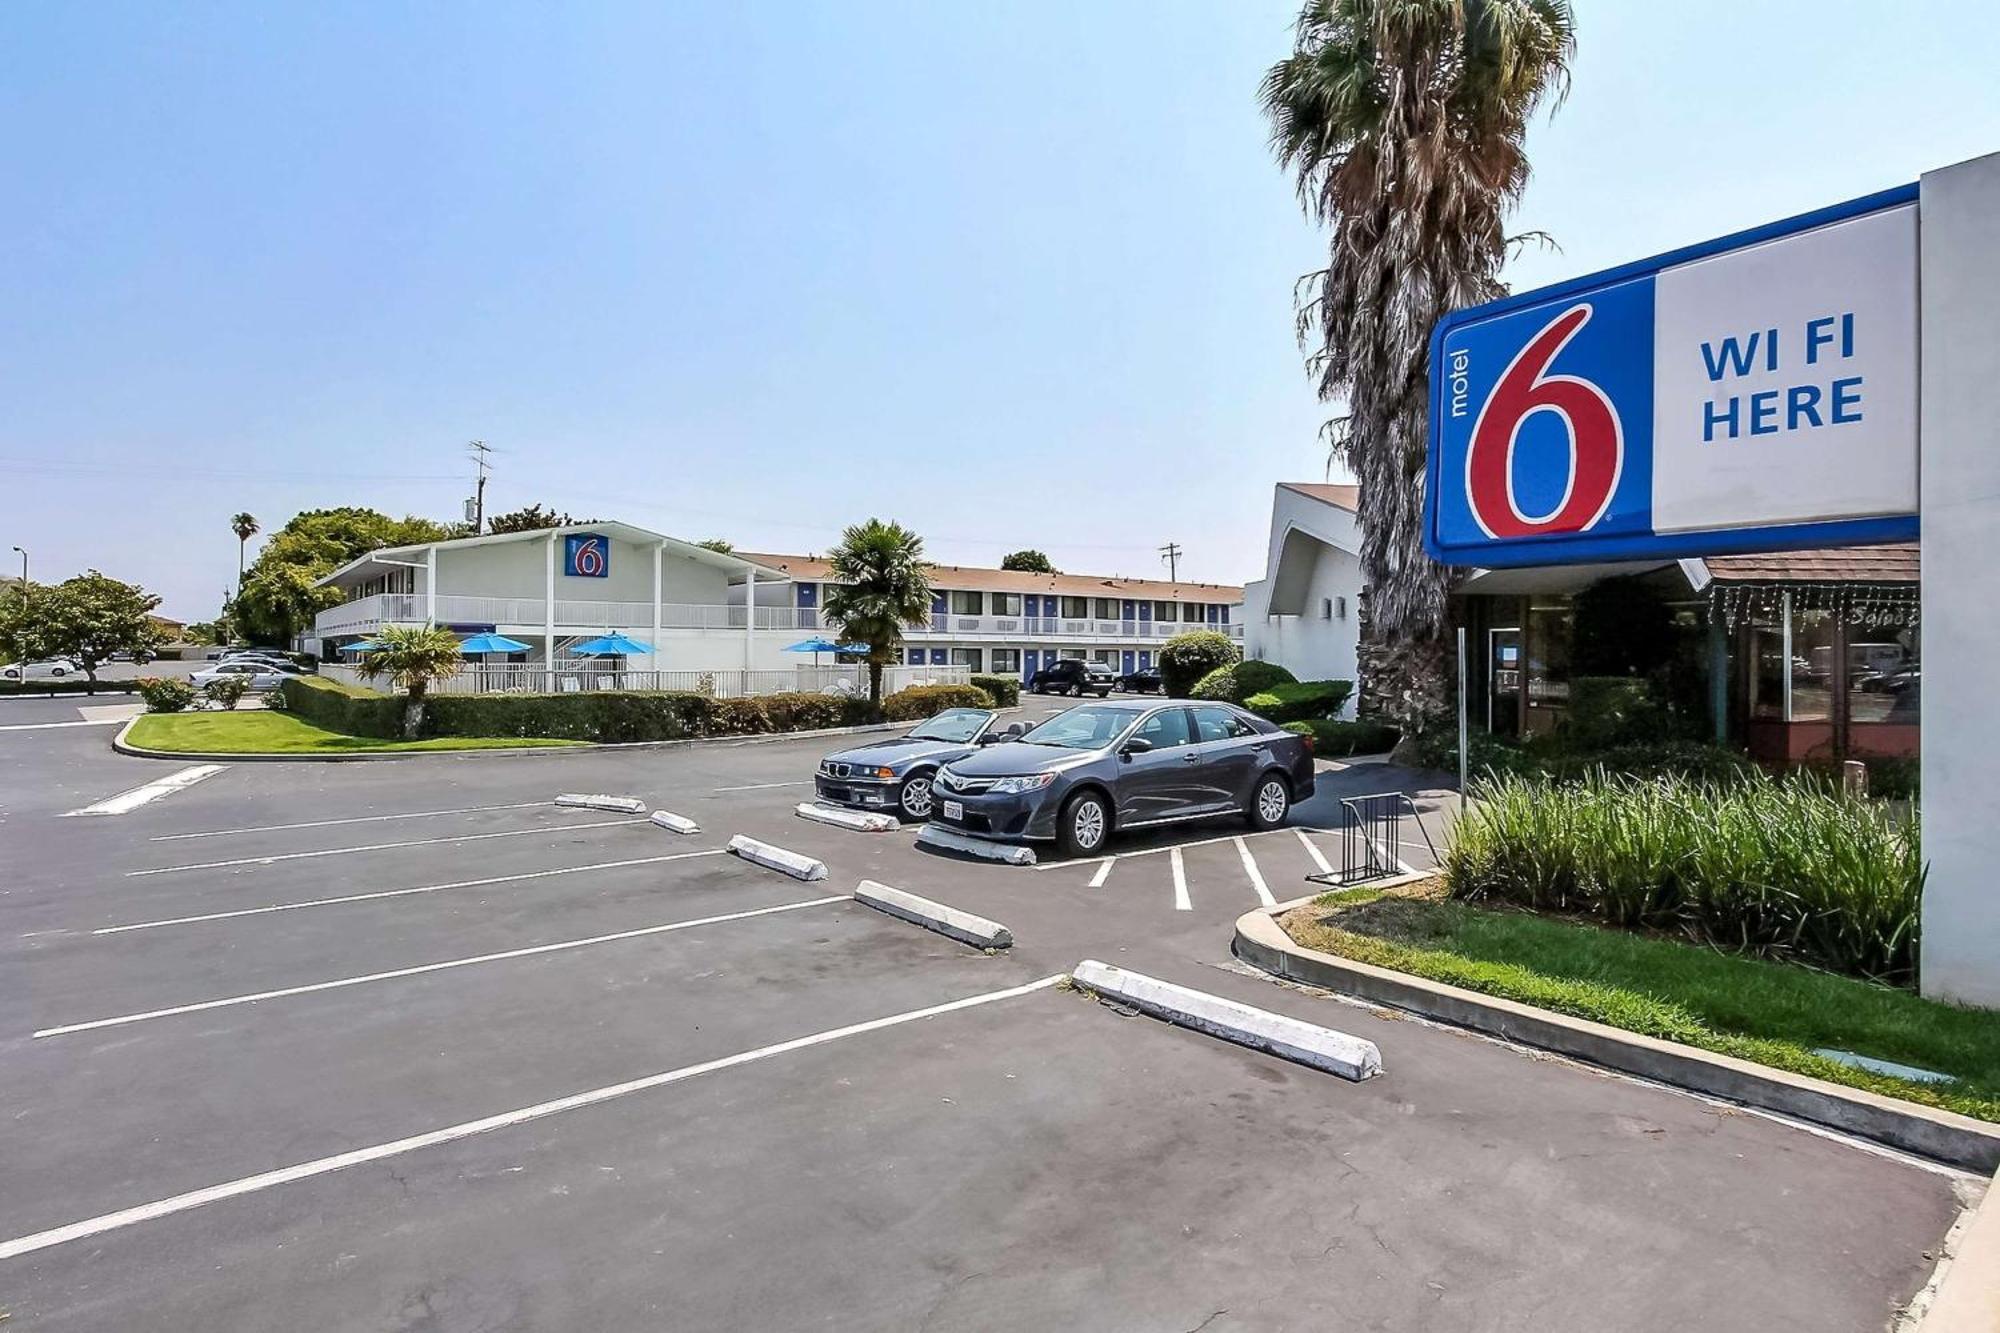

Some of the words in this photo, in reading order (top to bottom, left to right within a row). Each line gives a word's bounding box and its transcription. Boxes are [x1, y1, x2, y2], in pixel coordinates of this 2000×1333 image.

[1700, 328, 1778, 382] WI
[1806, 312, 1854, 365] FI
[1449, 348, 1470, 418] motel
[1464, 303, 1625, 540] 6
[1703, 376, 1863, 442] HERE
[575, 538, 604, 576] 6
[1850, 606, 1904, 625] Salad
